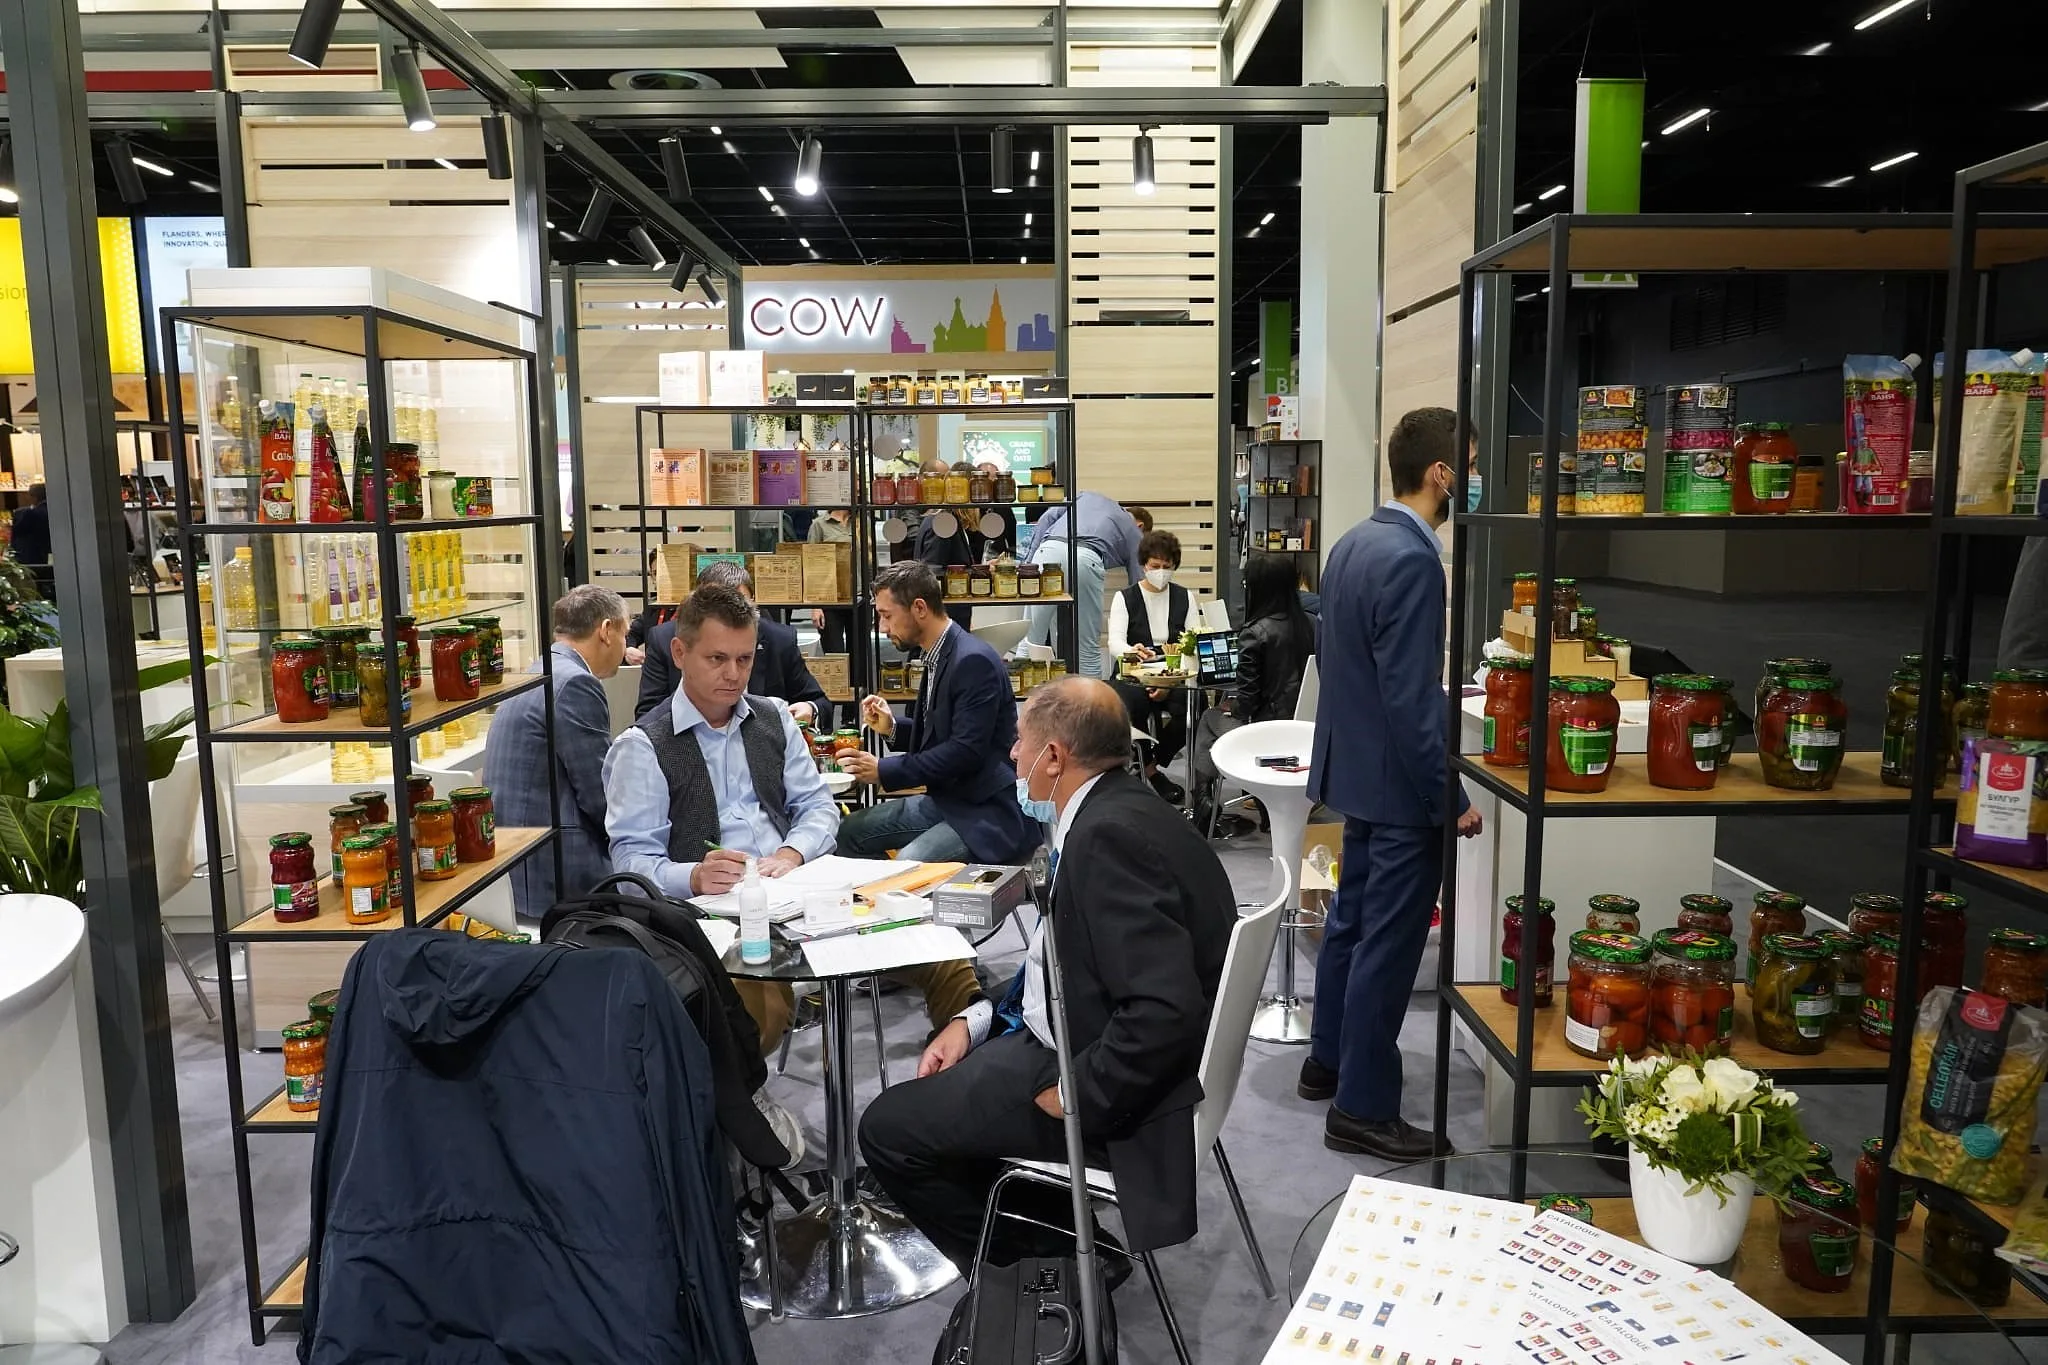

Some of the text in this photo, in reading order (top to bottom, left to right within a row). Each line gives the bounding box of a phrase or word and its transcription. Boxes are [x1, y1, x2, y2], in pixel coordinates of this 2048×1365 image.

[1276, 377, 1289, 394] B
[1546, 1213, 1601, 1239] CATALOGUE
[1597, 1314, 1654, 1353] CATALOGUE
